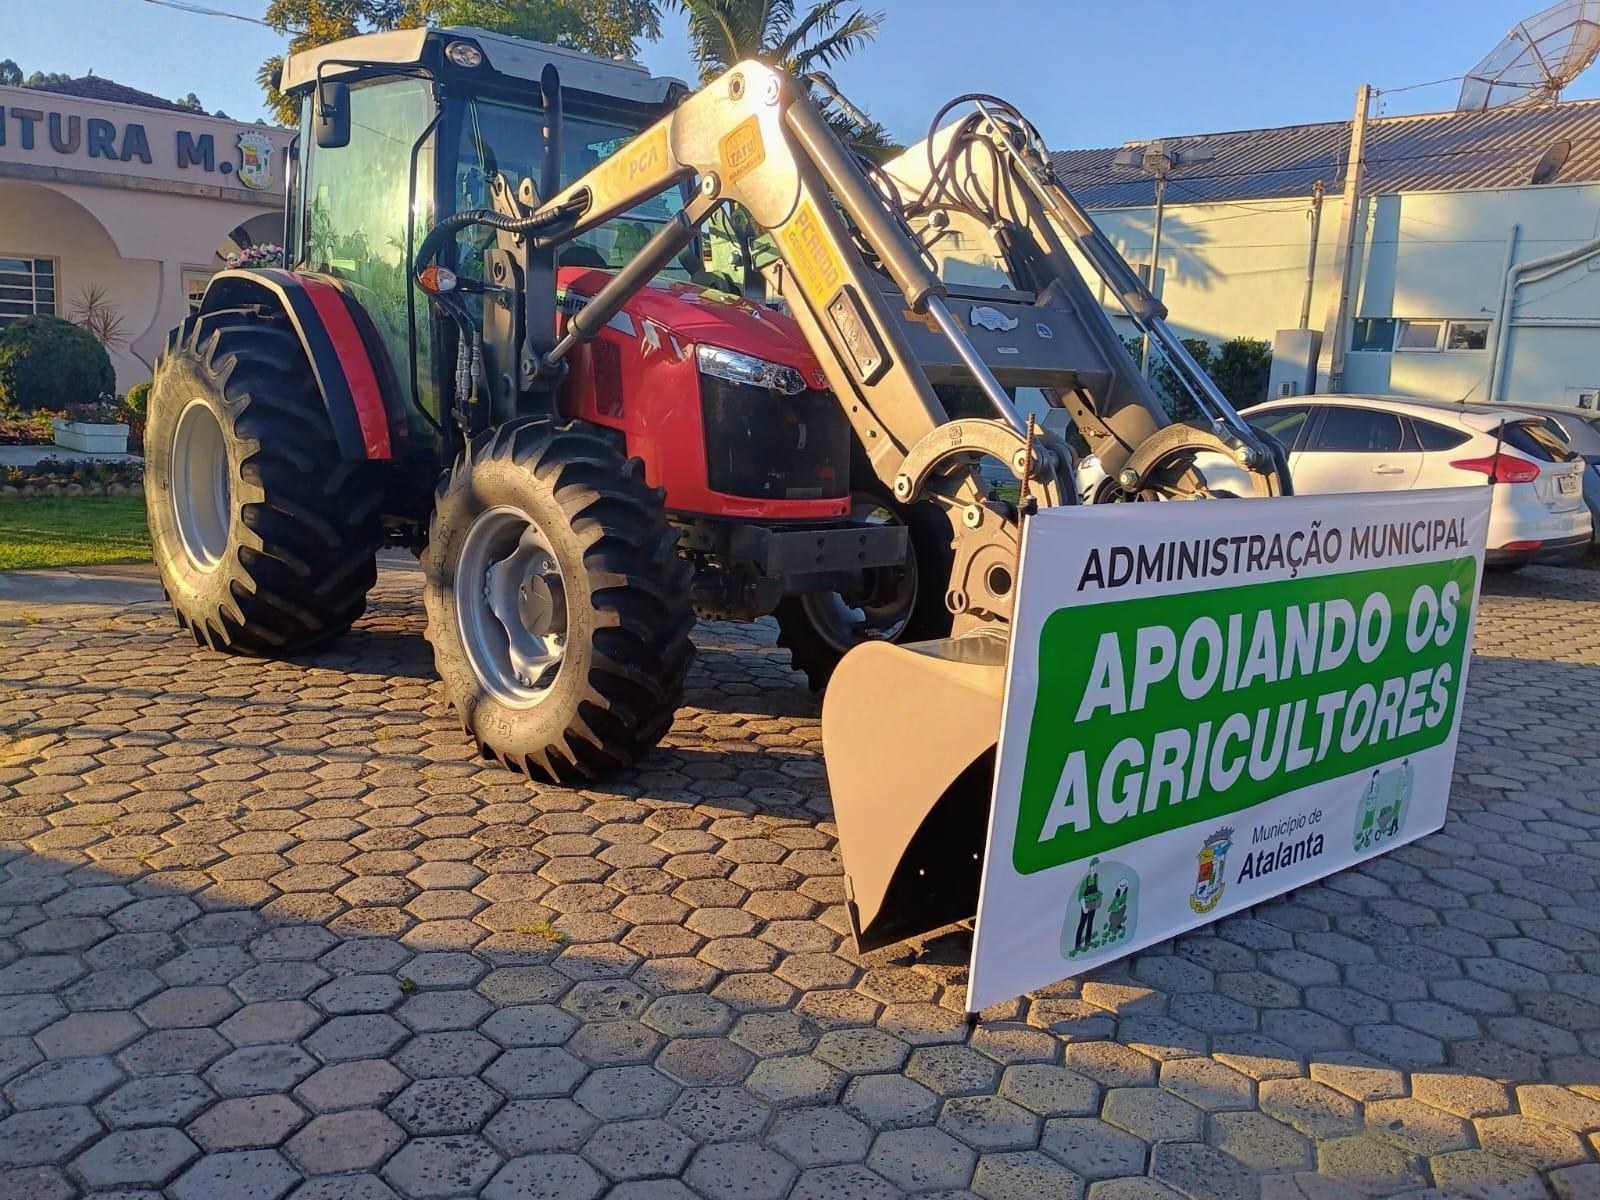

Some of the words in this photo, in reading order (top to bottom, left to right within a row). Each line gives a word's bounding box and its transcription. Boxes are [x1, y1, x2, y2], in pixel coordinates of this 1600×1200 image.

[177, 131, 233, 174] M.
[730, 140, 754, 164] TATU
[1077, 521, 1342, 591] ADMINISTRAÇÃO
[1350, 518, 1468, 560] MUNICIPAL
[1074, 591, 1392, 723] APOIANDO
[1406, 580, 1460, 654] OS
[1037, 663, 1452, 843] AGRICULTORES
[1252, 813, 1307, 845] Município
[1308, 808, 1323, 825] de
[1237, 832, 1324, 884] Atalanta
